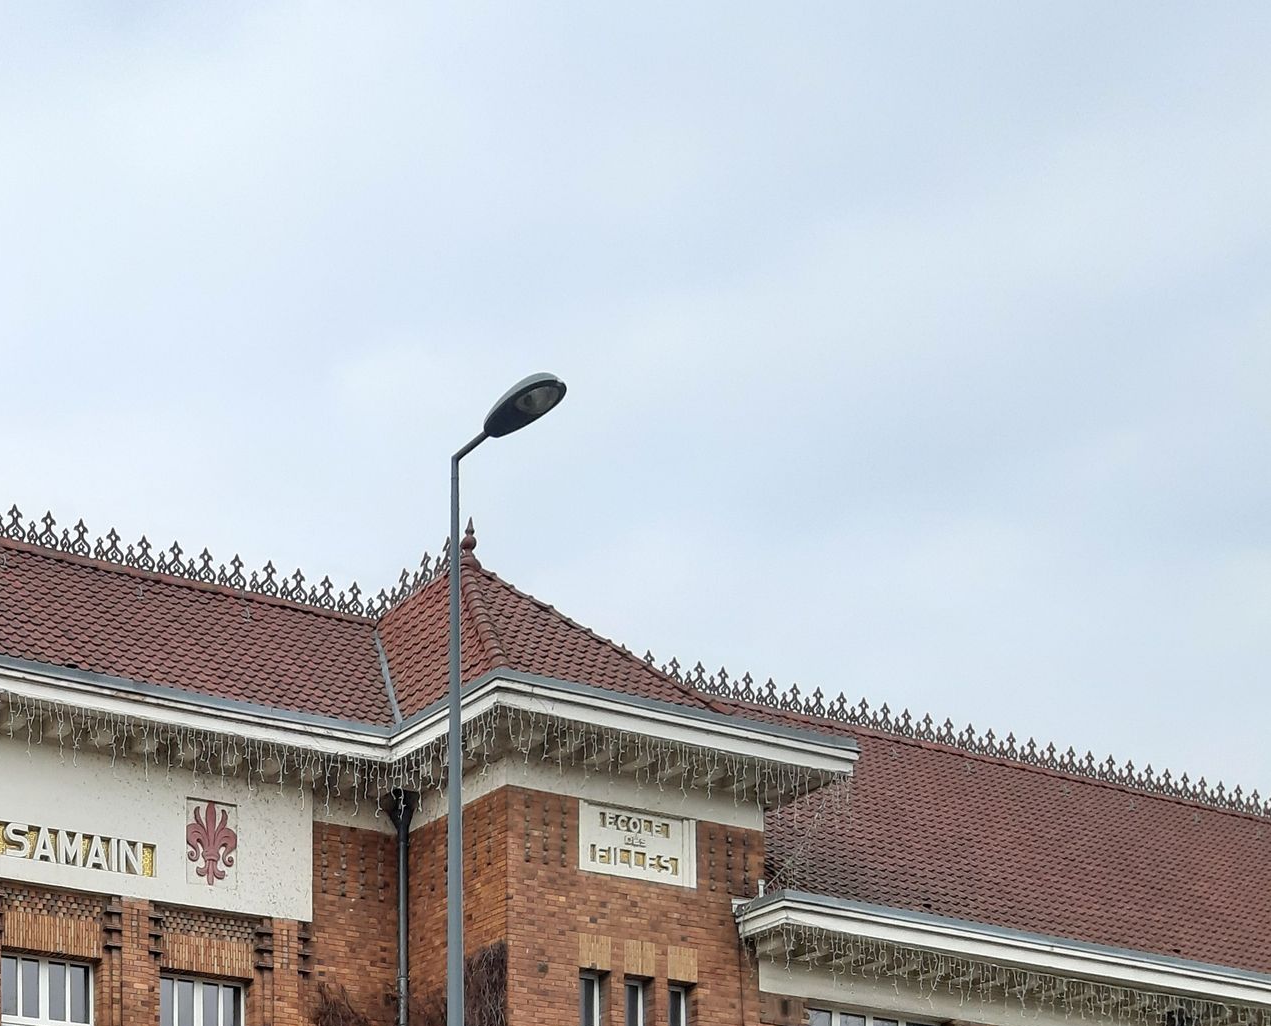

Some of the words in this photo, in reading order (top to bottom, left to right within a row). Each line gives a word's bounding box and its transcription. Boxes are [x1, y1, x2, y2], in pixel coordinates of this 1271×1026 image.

[606, 811, 665, 839] ECOLE
[4, 822, 143, 876] SAMAIN
[595, 843, 673, 876] FILLES
